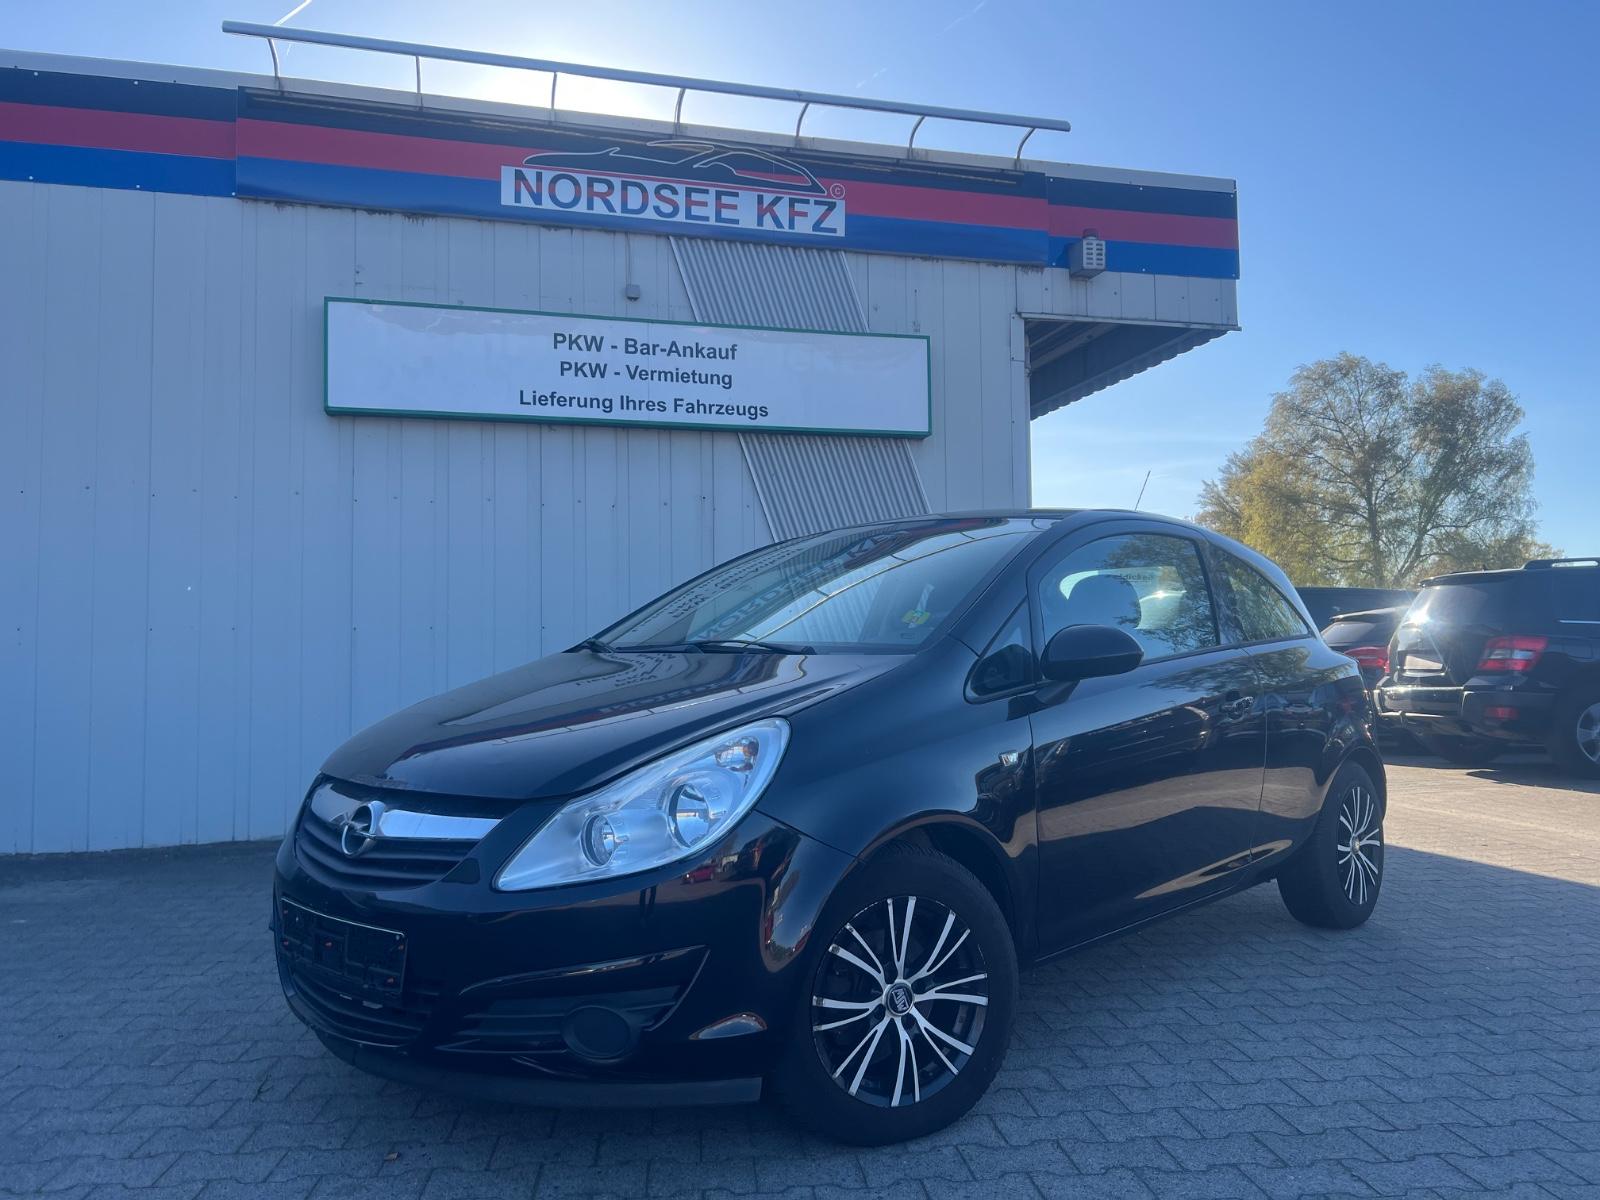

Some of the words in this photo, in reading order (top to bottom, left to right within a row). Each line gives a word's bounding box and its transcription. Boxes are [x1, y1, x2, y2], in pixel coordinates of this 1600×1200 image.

[513, 168, 741, 226] NORDSEE
[756, 194, 838, 234] KFZ
[553, 332, 604, 353] PKW
[624, 337, 738, 361] Bar-Ankauf
[560, 361, 608, 379] PKW
[625, 364, 733, 390] Vermietung
[519, 389, 614, 413] Lieferung
[620, 395, 667, 412] Ihres
[673, 397, 769, 420] Fahrzeugs
